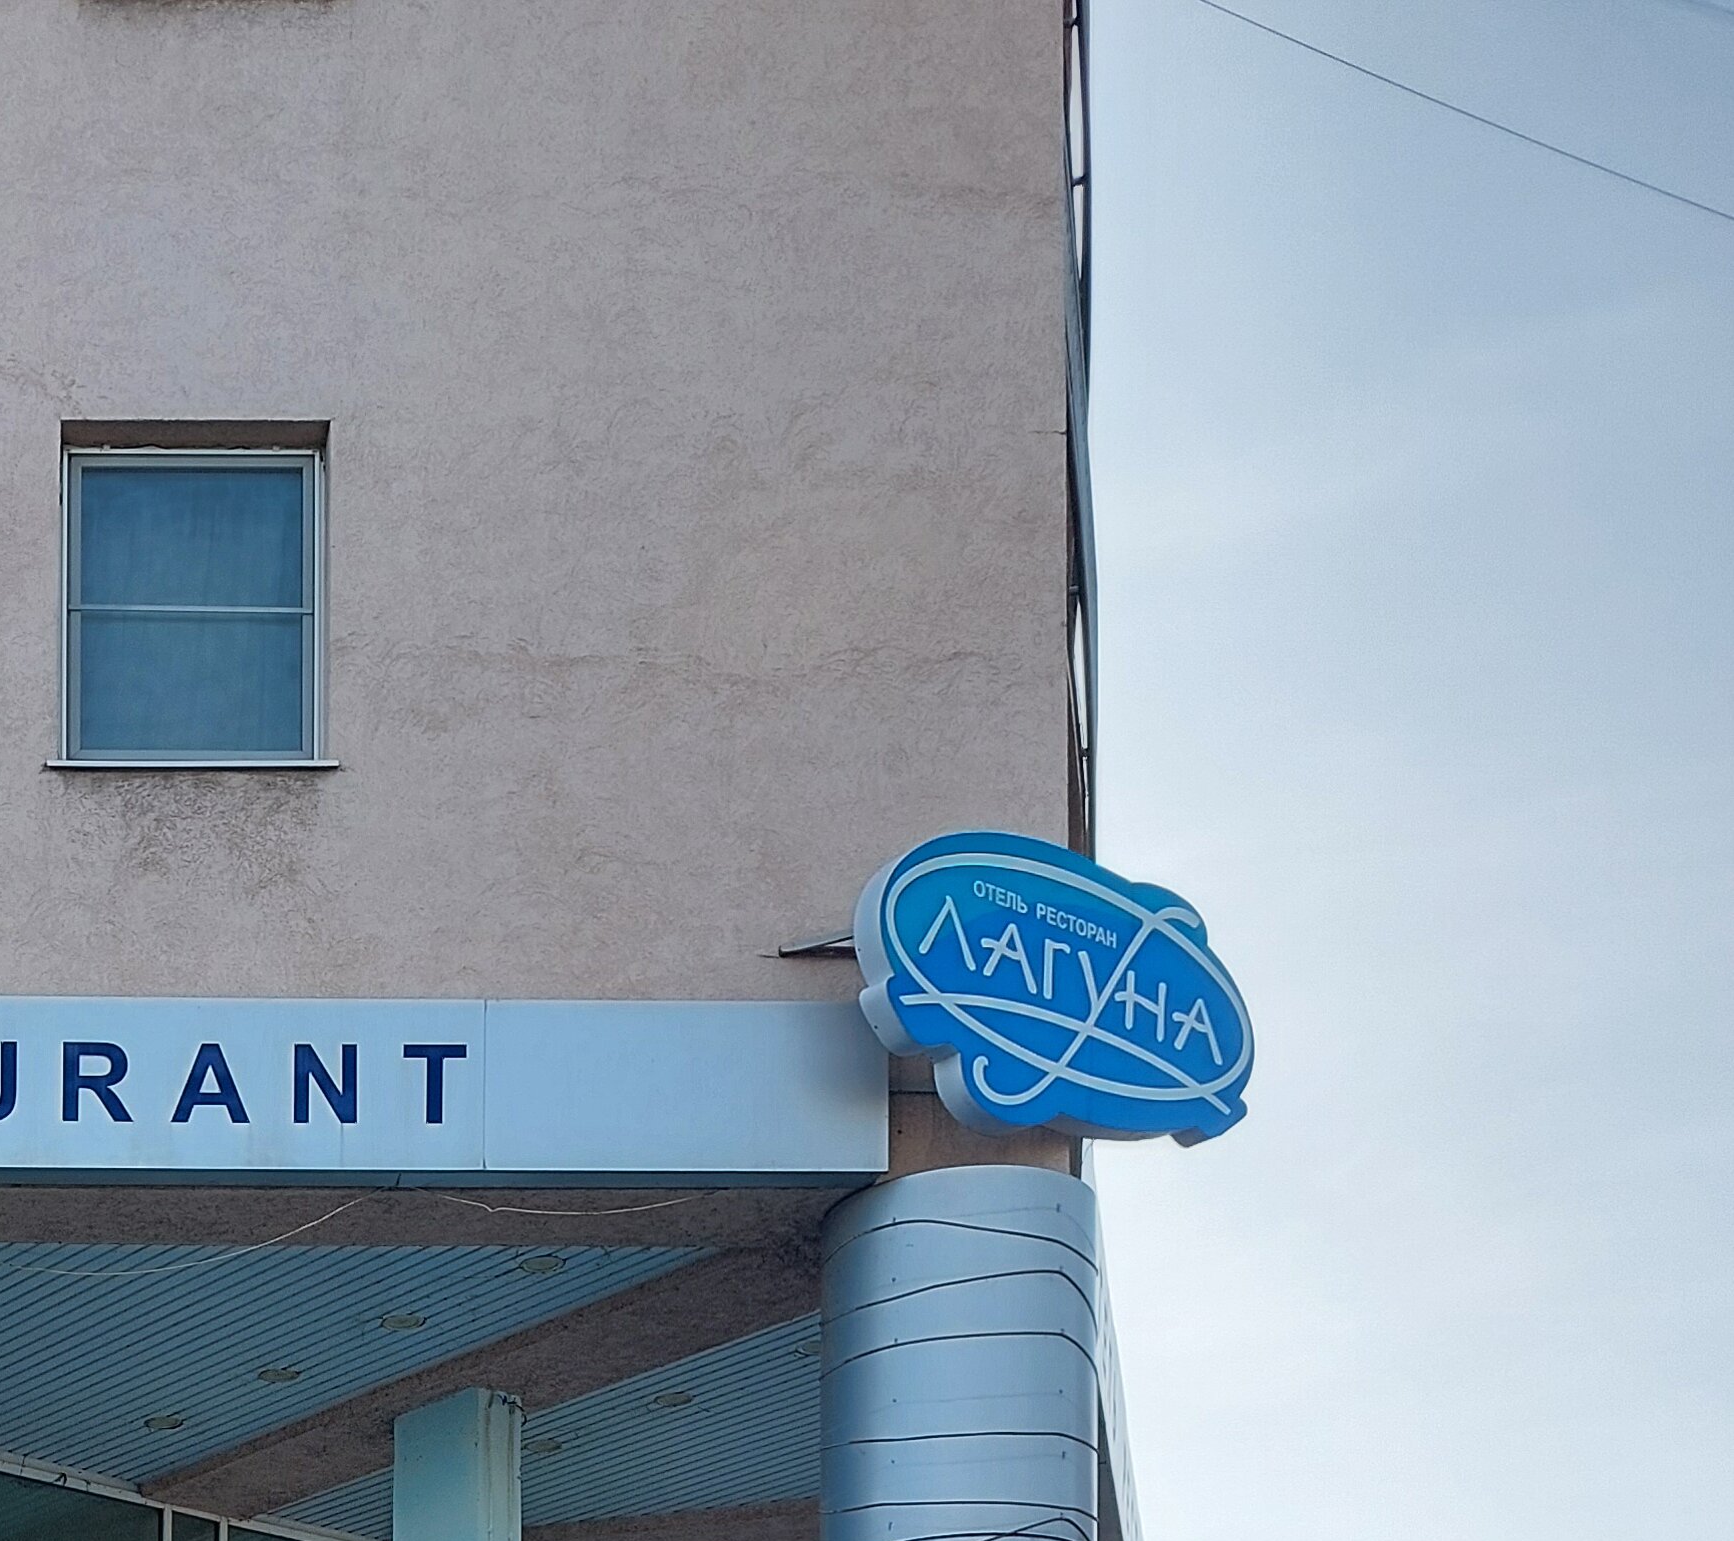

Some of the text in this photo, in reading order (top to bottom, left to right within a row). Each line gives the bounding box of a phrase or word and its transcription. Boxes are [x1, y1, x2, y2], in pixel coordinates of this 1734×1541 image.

[973, 880, 1117, 949] ОТЕЛЬ РЕСТОРАН
[918, 895, 1223, 1066] ЛАГУНА
